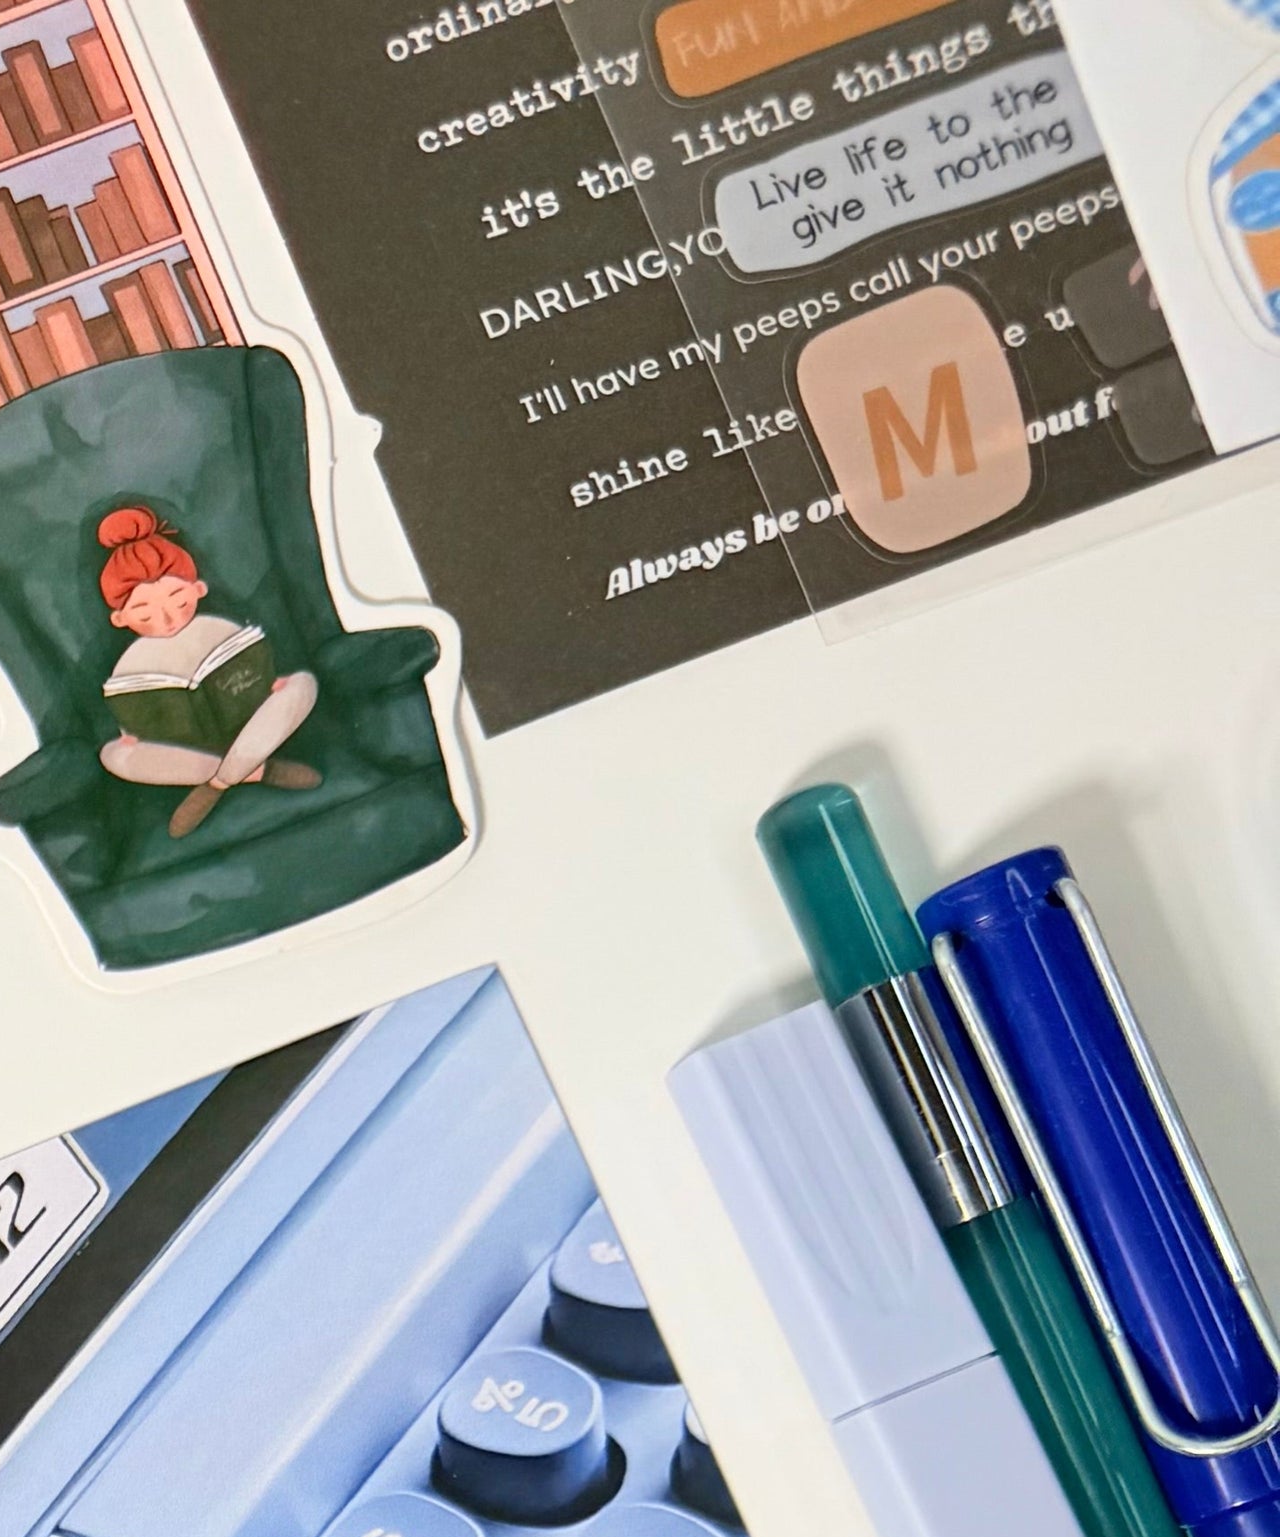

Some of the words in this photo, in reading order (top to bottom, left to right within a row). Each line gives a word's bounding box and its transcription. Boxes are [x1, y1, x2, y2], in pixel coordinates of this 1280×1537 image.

[417, 50, 639, 153] creativity
[480, 190, 560, 239] it's
[576, 154, 656, 200] the
[671, 92, 816, 166] little
[832, 21, 991, 103] things
[748, 165, 828, 211] Live
[842, 133, 908, 176] life
[926, 110, 971, 145] to
[989, 76, 1059, 121] the
[792, 194, 866, 249] give
[882, 176, 917, 208] it
[935, 116, 1074, 191] nothing
[519, 383, 567, 424] I'll
[570, 357, 661, 405] have
[667, 332, 723, 371] my
[732, 288, 842, 354] peeps
[849, 256, 911, 303] call
[918, 229, 999, 283] your
[1008, 182, 1121, 251] peeps
[569, 447, 689, 509] shine
[701, 407, 799, 458] like
[861, 360, 978, 503] M
[604, 526, 748, 601] Always
[751, 508, 801, 545] be
